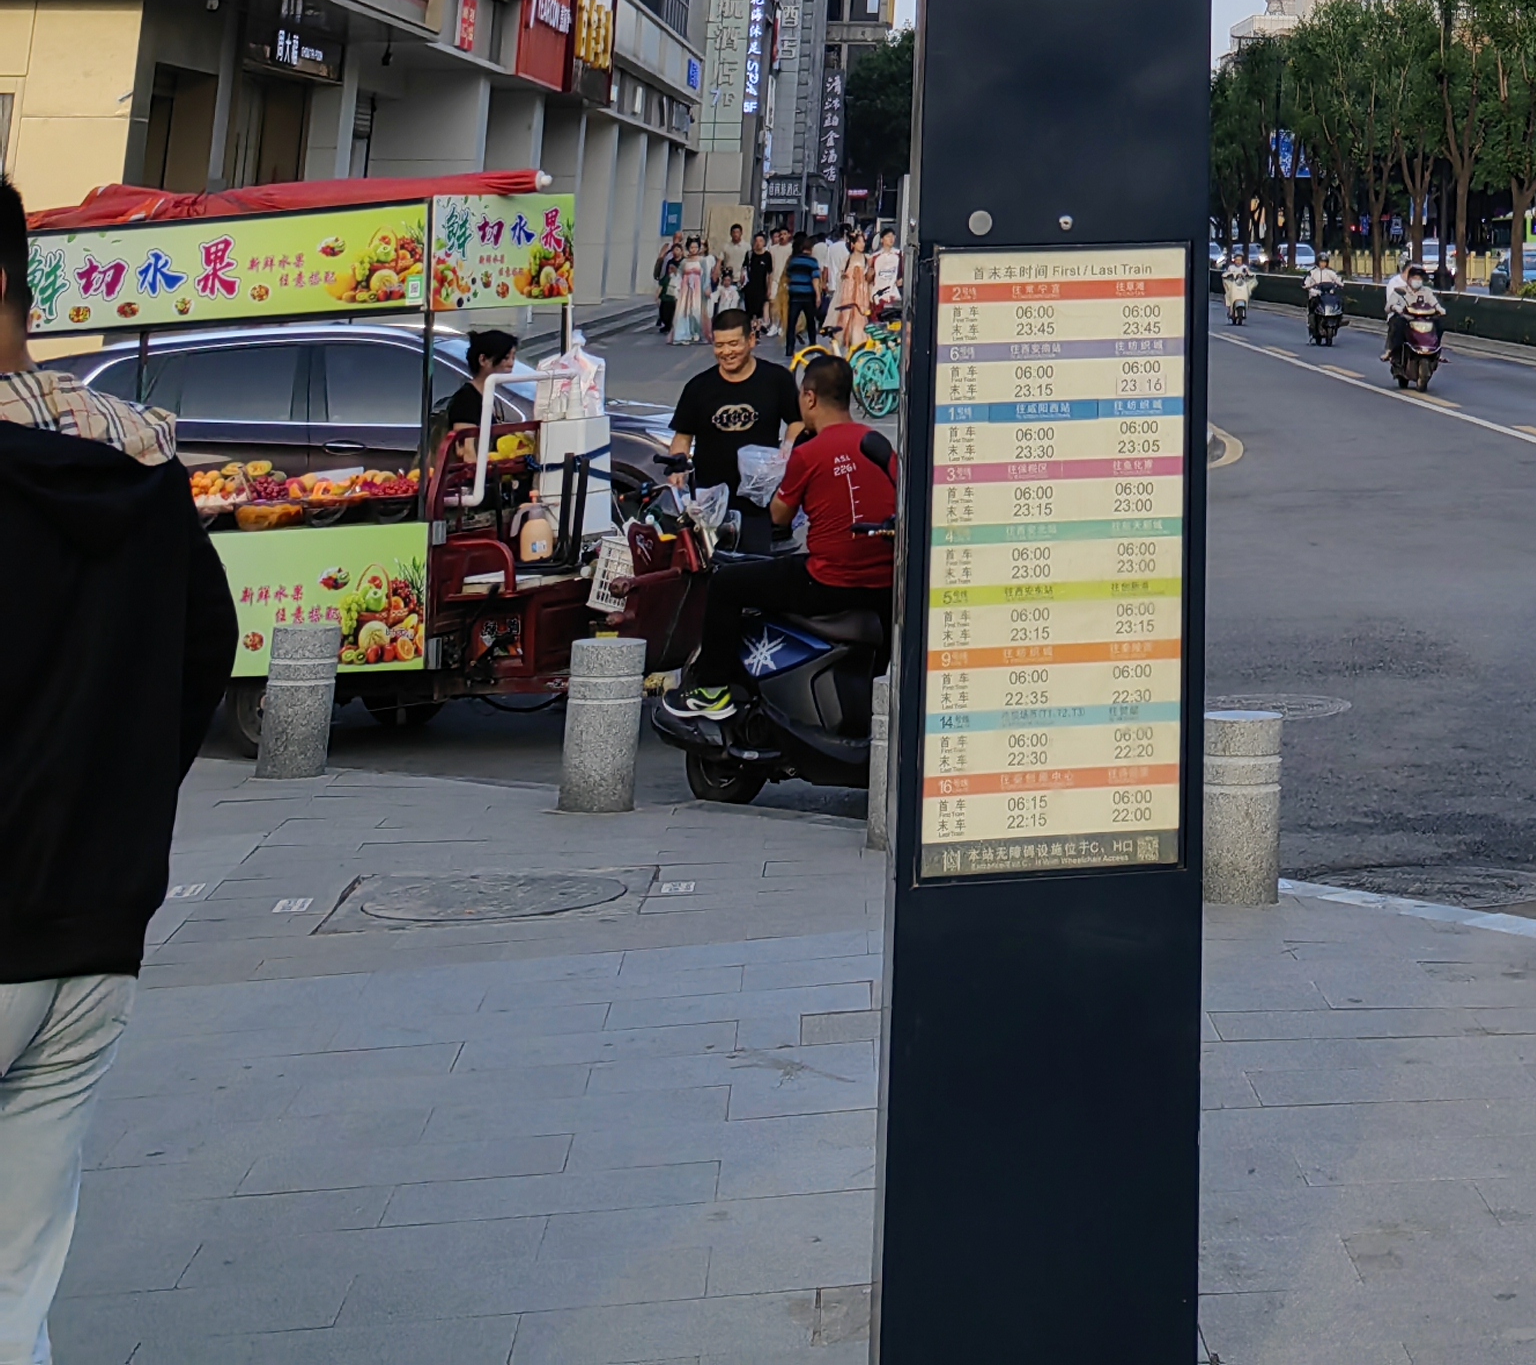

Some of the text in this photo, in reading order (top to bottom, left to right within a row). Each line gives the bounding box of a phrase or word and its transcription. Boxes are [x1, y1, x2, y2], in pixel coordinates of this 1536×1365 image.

[445, 205, 564, 260] 鲜切水果
[1052, 265, 1081, 277] First
[1091, 264, 1118, 276] Last
[1120, 264, 1152, 275] Train
[1015, 305, 1054, 320] 06:00
[1122, 304, 1161, 318] 06:00
[1016, 322, 1055, 336] 23:45
[1123, 321, 1161, 335] 23:45
[1015, 365, 1054, 380] 06:00
[1122, 360, 1161, 374] 06:00
[1015, 427, 1055, 442] 06:00
[1119, 420, 1159, 435] 06:00
[1015, 444, 1055, 459] 23:30
[1117, 439, 1160, 454] 23:05
[1014, 486, 1053, 500] 06:00
[1115, 482, 1154, 496] 06:00
[1013, 502, 1053, 517] 23:15
[1113, 498, 1153, 513] 23:00
[1011, 547, 1051, 562] 06:00
[1117, 542, 1156, 556] 06:00
[1011, 564, 1051, 579] 23:00
[1117, 559, 1156, 573] 23:00
[239, 584, 304, 606] 新鲜水果
[1010, 608, 1050, 623] 06:00
[1116, 602, 1155, 617] 06:00
[1010, 627, 1050, 642] 23:15
[1115, 619, 1154, 634] 23:15
[1009, 669, 1049, 684] 06:00
[1112, 663, 1152, 679] 06:00
[1005, 690, 1049, 706] 22:35
[1112, 688, 1152, 704] 22:30
[1008, 732, 1048, 748] 06:00
[1114, 726, 1153, 742] 06:00
[1007, 751, 1048, 766] 22:30
[1007, 795, 1047, 811] 06:15
[1112, 789, 1152, 805] 06:00
[1006, 813, 1047, 829] 22:15
[1112, 807, 1152, 823] 22:00
